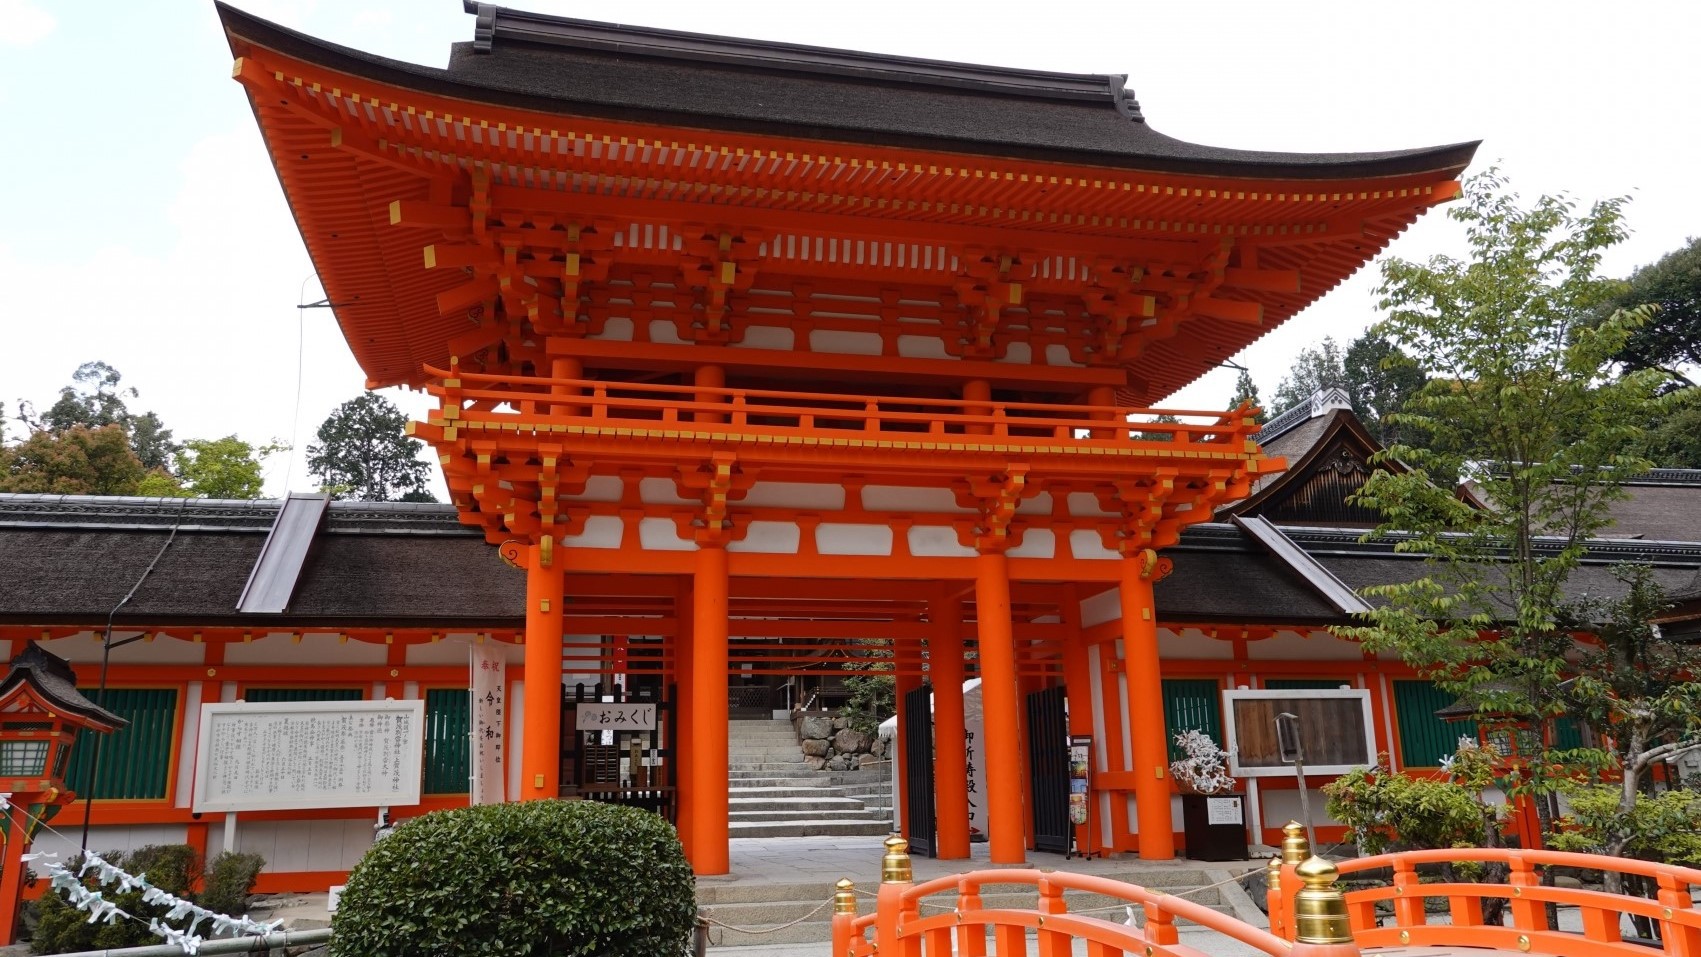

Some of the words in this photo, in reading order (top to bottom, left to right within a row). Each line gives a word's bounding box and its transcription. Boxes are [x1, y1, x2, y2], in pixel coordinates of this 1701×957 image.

[481, 659, 500, 672] 奉祝
[485, 690, 495, 741] 令和
[599, 707, 652, 726] おみくじ
